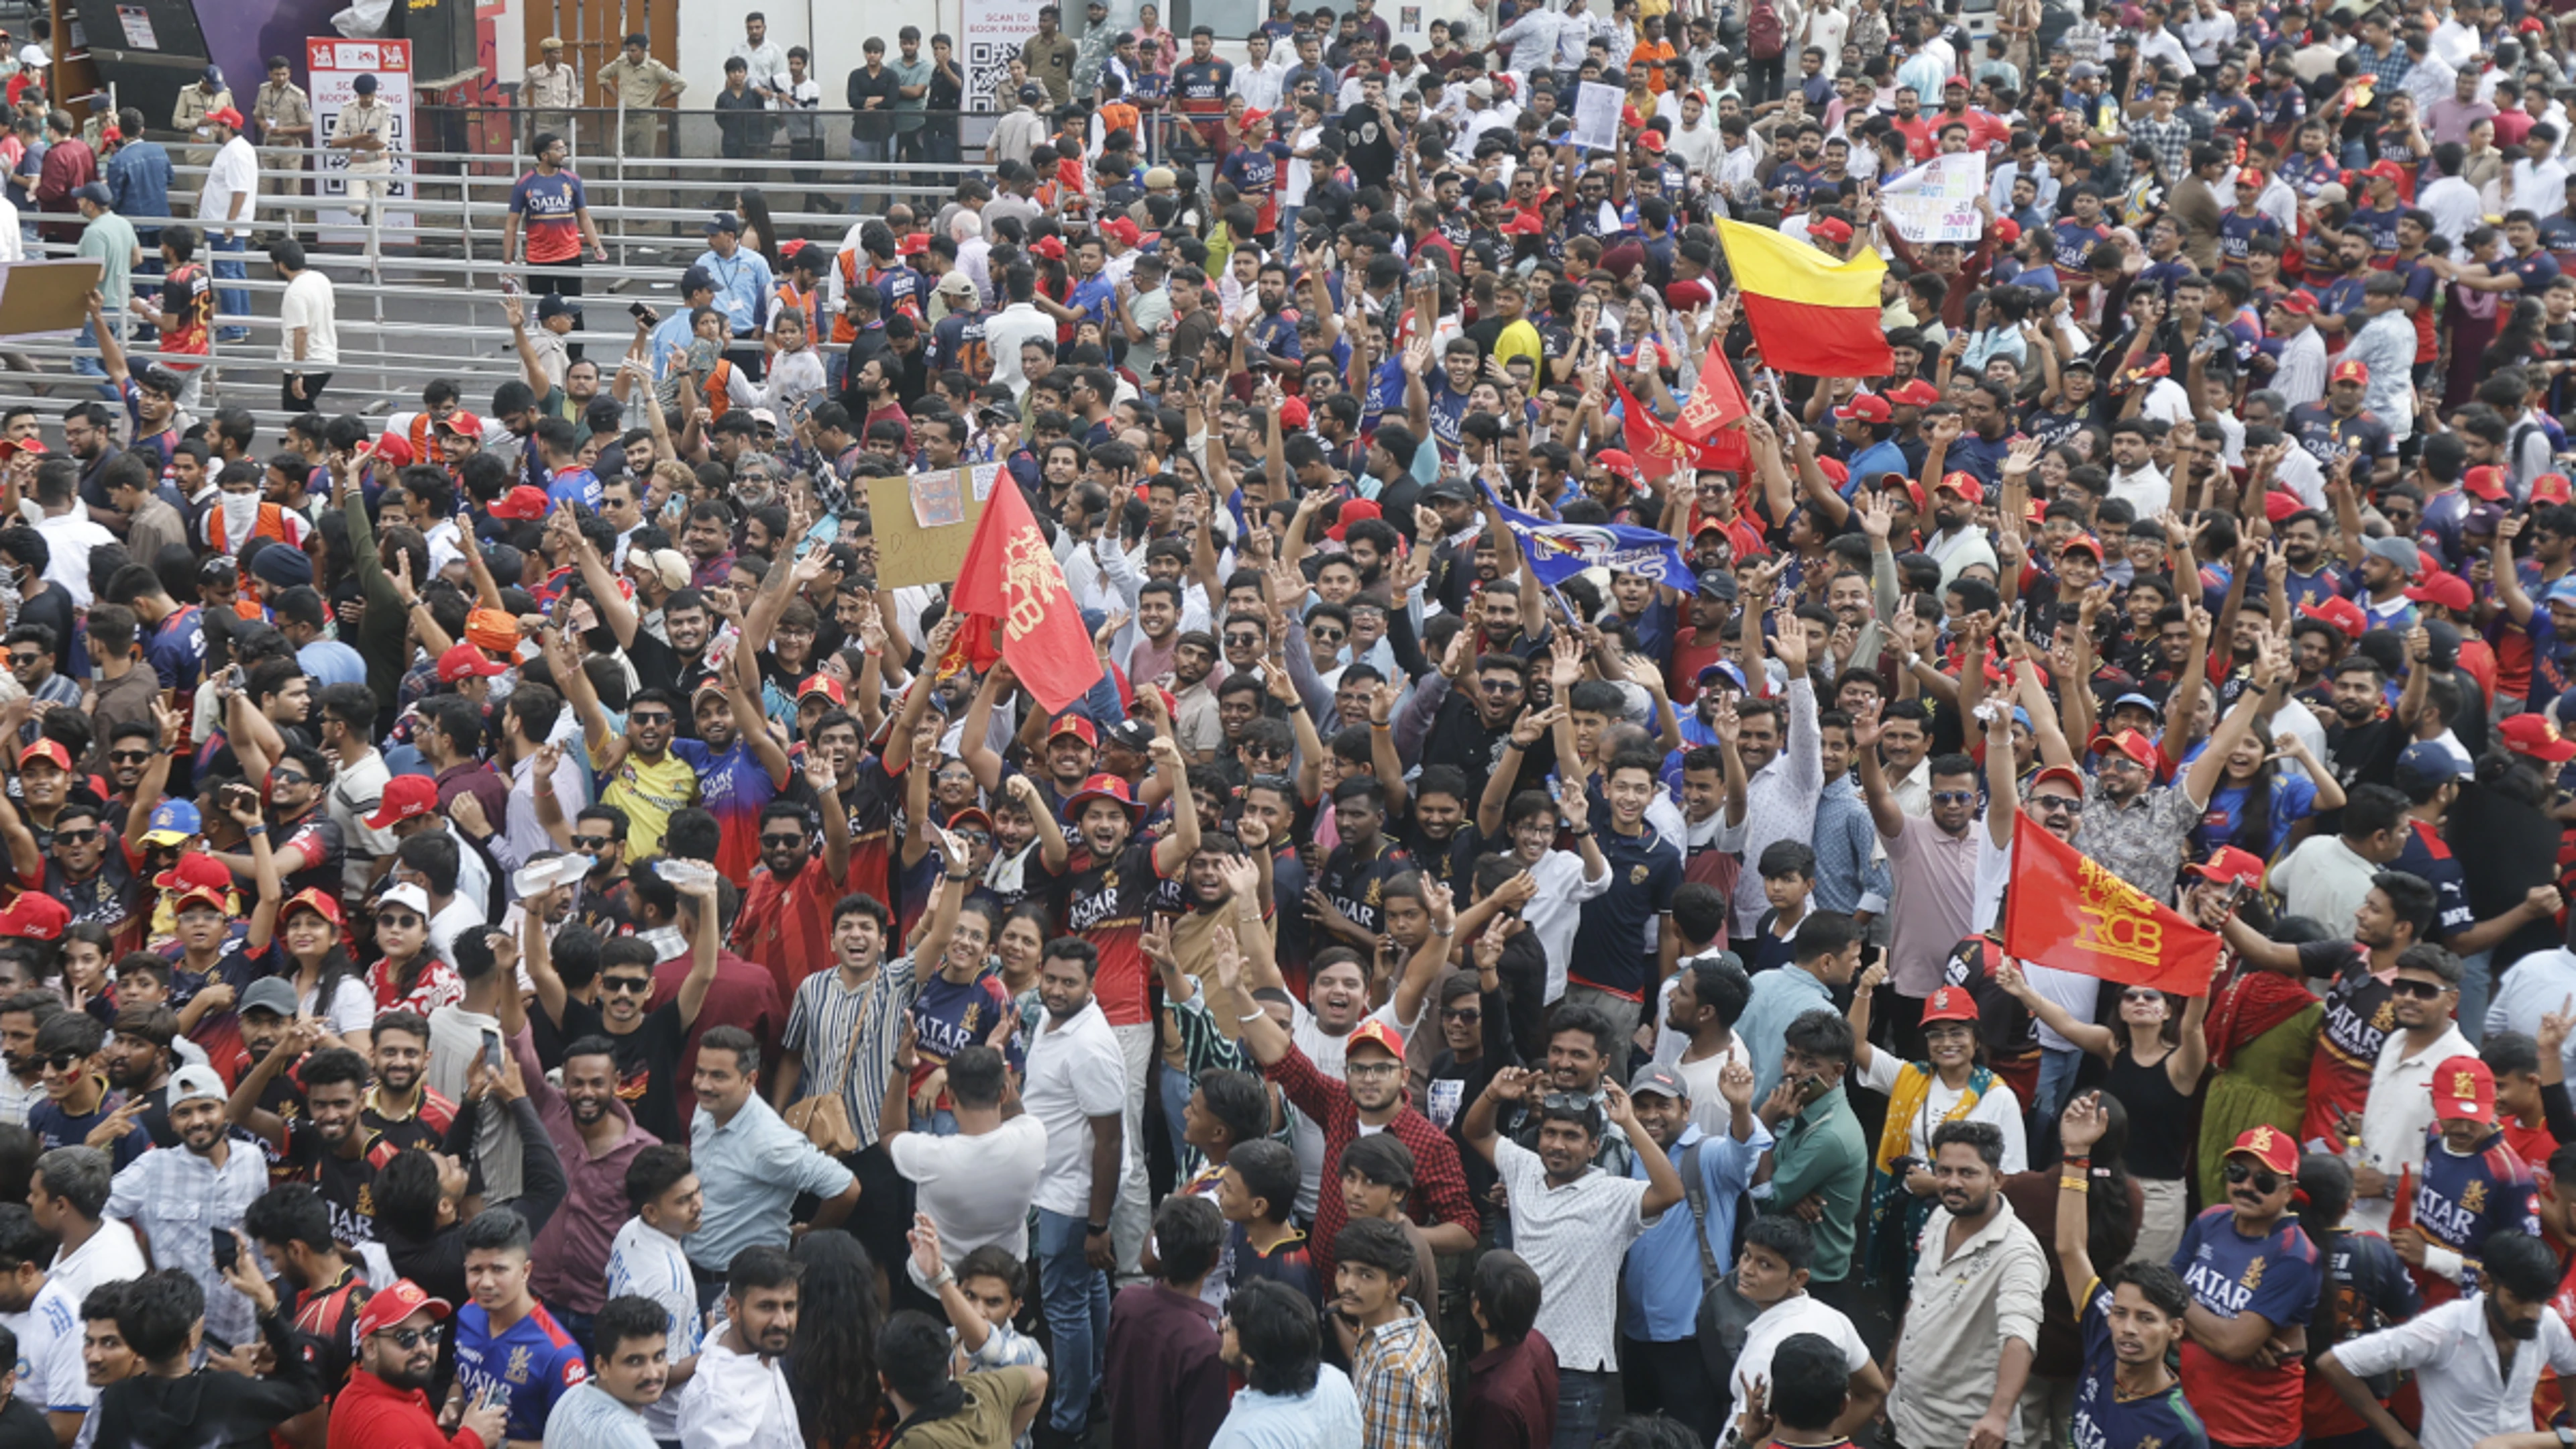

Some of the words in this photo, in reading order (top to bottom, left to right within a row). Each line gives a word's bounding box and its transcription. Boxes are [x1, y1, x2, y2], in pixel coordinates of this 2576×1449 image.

[337, 81, 356, 91] SC
[2304, 439, 2348, 460] QATA
[2078, 906, 2163, 954] RCB
[916, 1013, 971, 1050] ATAR
[327, 1199, 374, 1238] TAR
